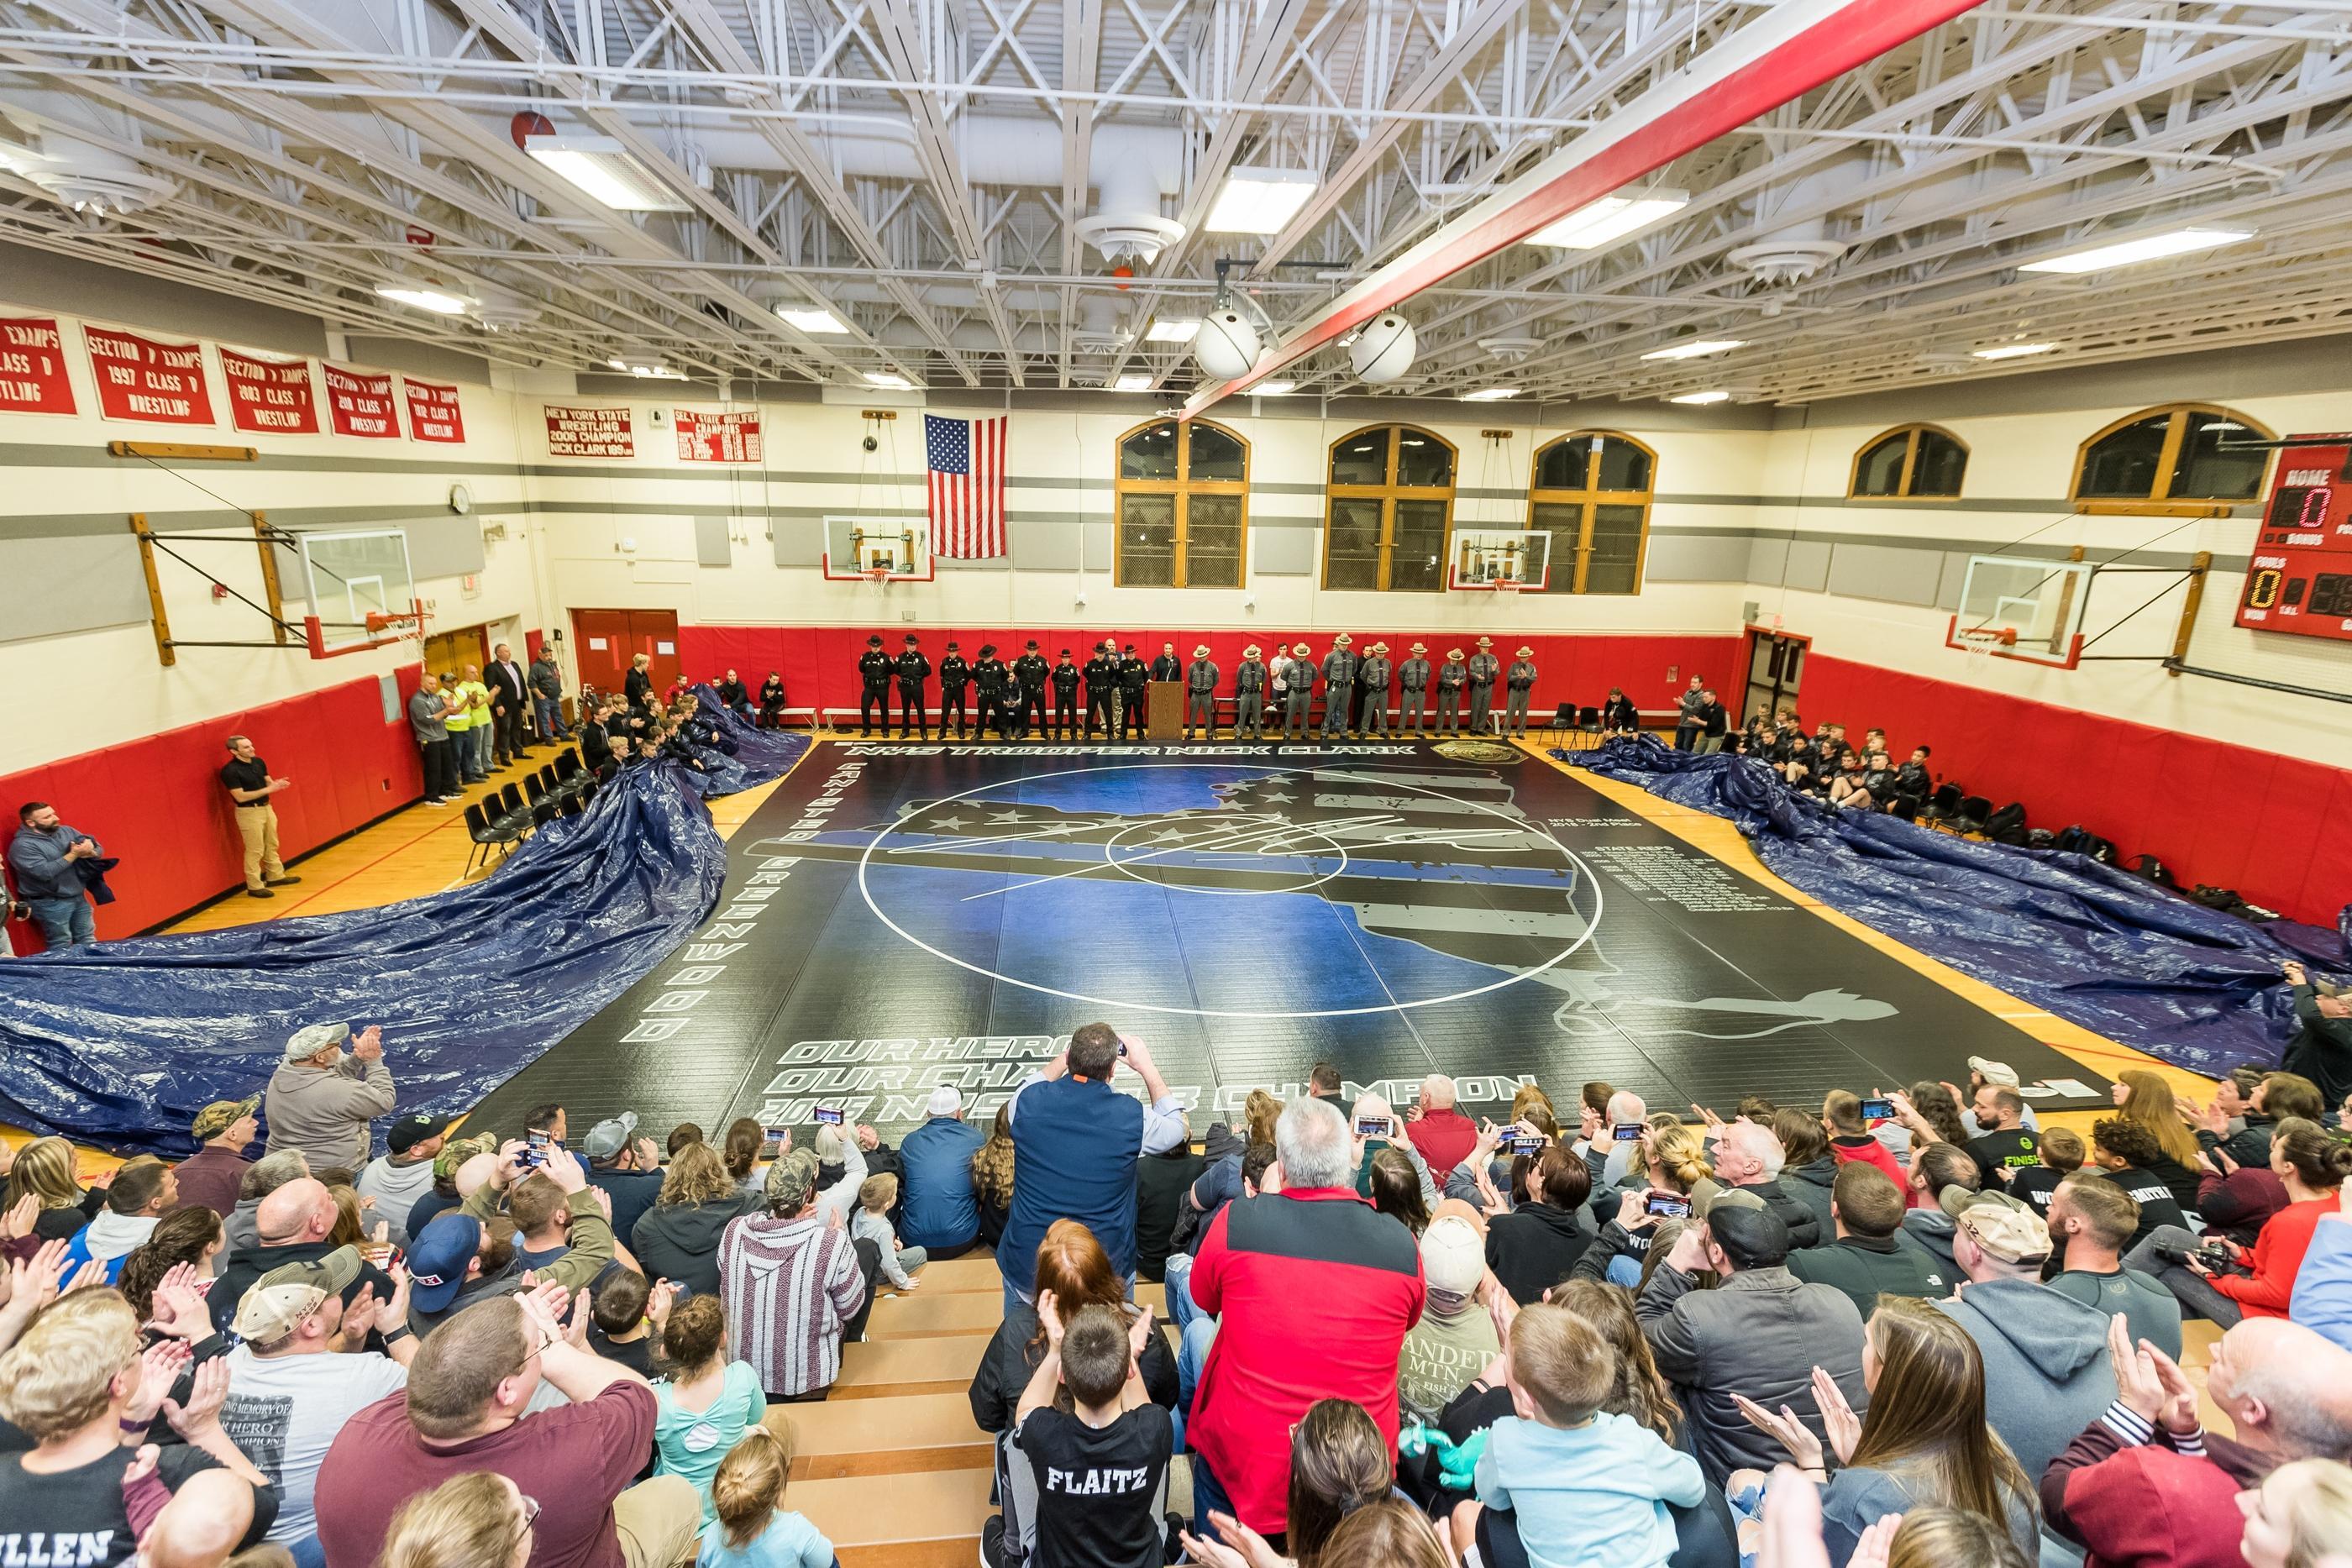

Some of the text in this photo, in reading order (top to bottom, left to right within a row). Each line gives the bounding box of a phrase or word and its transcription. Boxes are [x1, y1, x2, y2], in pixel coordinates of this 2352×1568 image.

[4, 325, 59, 349] CHAMPS
[88, 335, 140, 361] SECTION
[161, 349, 202, 370] CHAMPS
[0, 352, 52, 375] ASS D
[223, 357, 266, 382] SECTION
[281, 368, 309, 385] CHAMPS
[108, 364, 197, 393] 1997 CLASS D
[326, 372, 359, 393] SECTION
[0, 380, 41, 402] TLING
[265, 387, 295, 406] CLASS
[406, 383, 429, 401] SECTION
[128, 393, 191, 417] WRESTLING
[357, 397, 382, 414] CLASS
[430, 406, 449, 421] CLASS
[545, 407, 630, 422] NEW YORK STATE
[253, 408, 302, 428] WRESTLING
[349, 416, 387, 433] WRESTLING
[558, 419, 620, 433] WRESTLING
[698, 413, 722, 424] STATE
[423, 422, 454, 438] WRESTLING
[579, 431, 632, 443] CHAMPION
[696, 422, 741, 434] CHAMPIONS
[550, 442, 574, 454] NICK
[574, 443, 607, 456] CLARK
[2285, 469, 2332, 487] HOME
[2299, 487, 2332, 528] 0
[2250, 569, 2281, 608] 0
[843, 744, 1417, 756] NYS TROOPER NICK CLARK
[619, 857, 803, 1043] GREENWOOD
[776, 1039, 918, 1064] OUR
[761, 1066, 913, 1094] OUR
[1212, 1075, 1537, 1112] CHMPON
[874, 1091, 1013, 1123] NS
[2004, 1155, 2042, 1167] FINISH
[1409, 1355, 1464, 1385] MTN.
[1423, 1381, 1447, 1393] FISH
[236, 1403, 276, 1415] MEMORY
[276, 1403, 291, 1415] OF
[231, 1422, 274, 1434] HERO
[1046, 1465, 1148, 1495] FLAITZ
